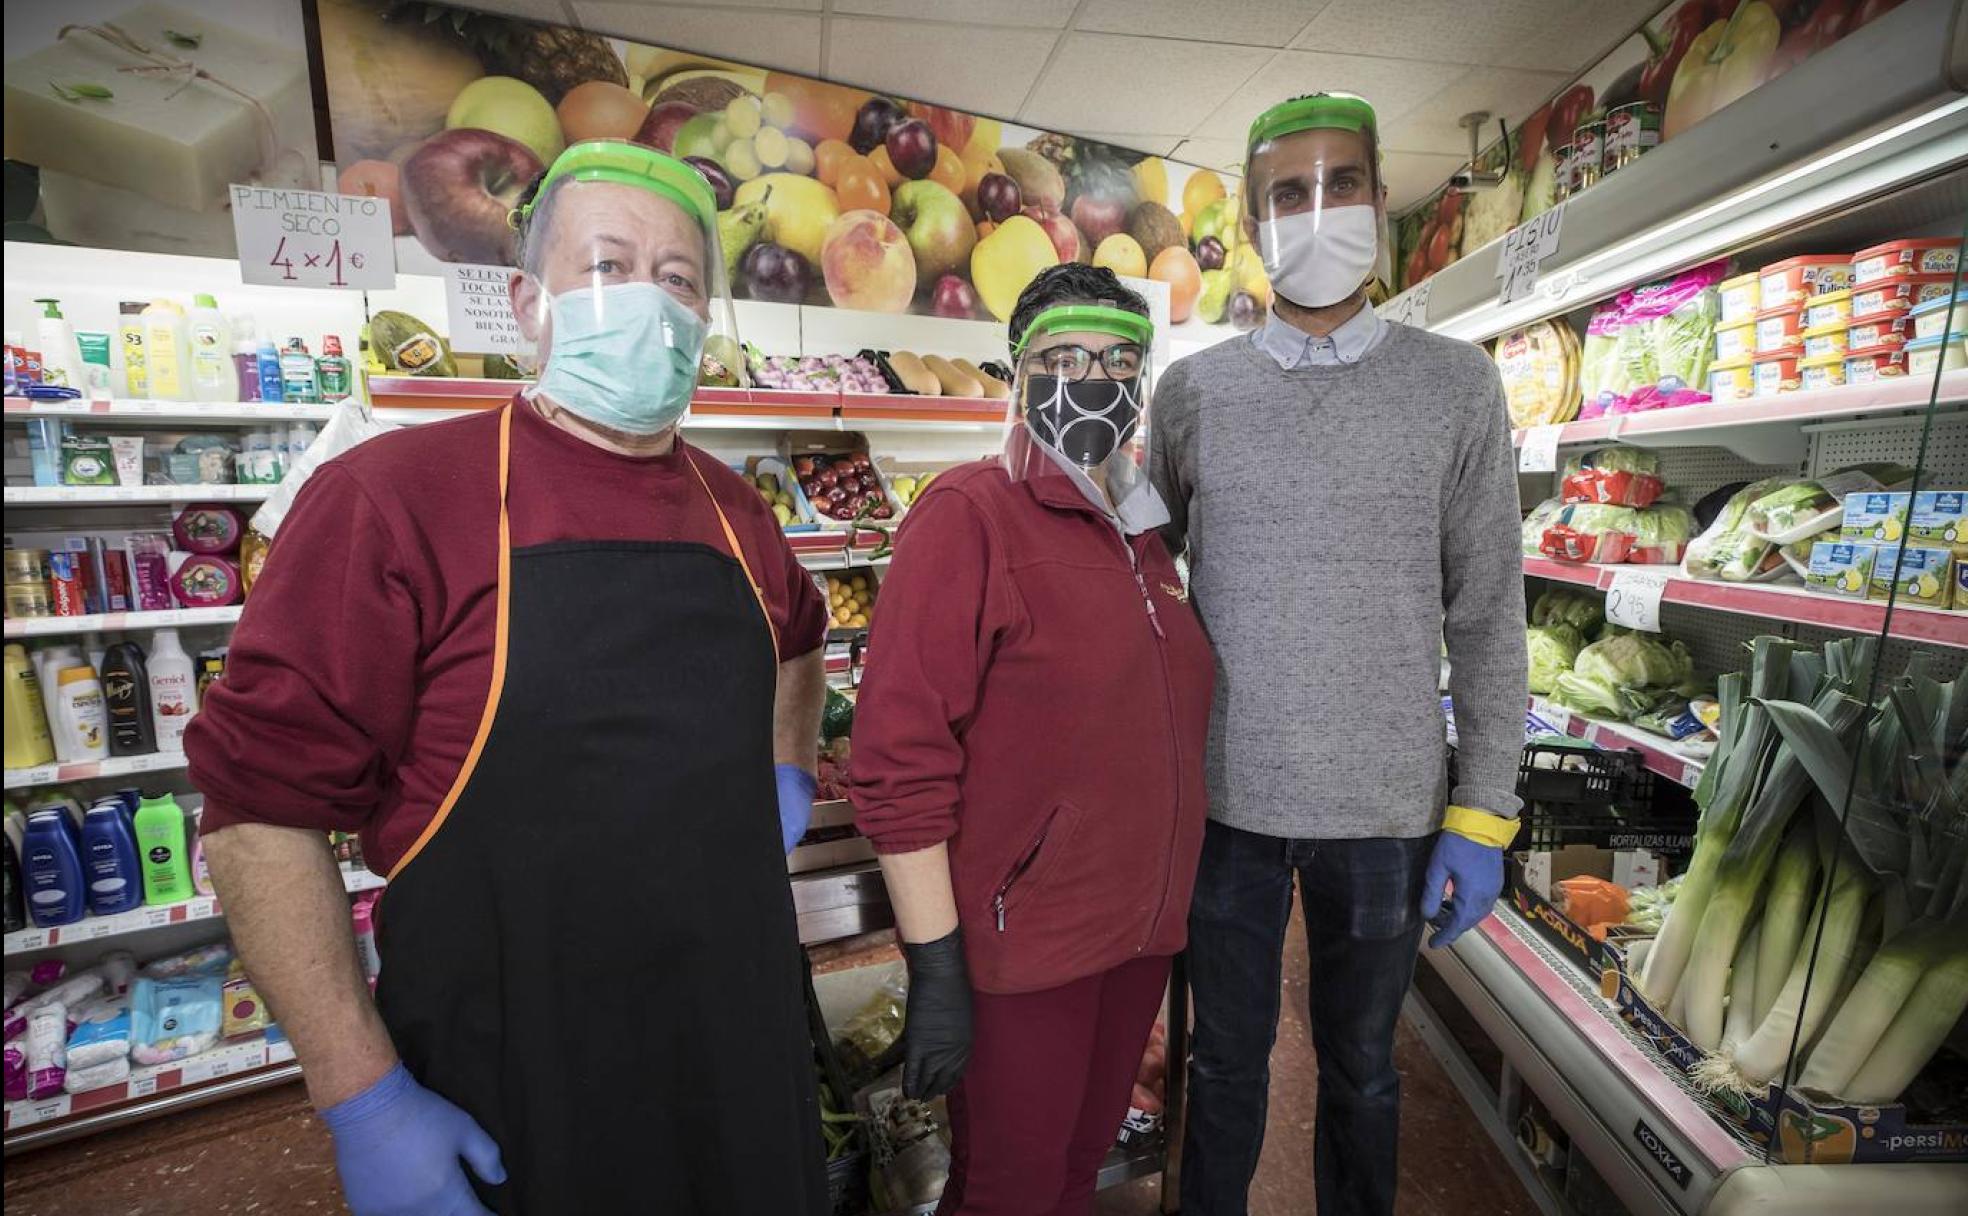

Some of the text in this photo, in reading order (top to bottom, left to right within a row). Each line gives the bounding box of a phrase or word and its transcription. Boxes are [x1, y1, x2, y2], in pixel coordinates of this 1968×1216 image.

[236, 188, 377, 215] PIMIENTO
[281, 212, 341, 236] SECO
[1609, 834, 1664, 848] HORTALIZAS
[1638, 1128, 1684, 1181] KOXKA
